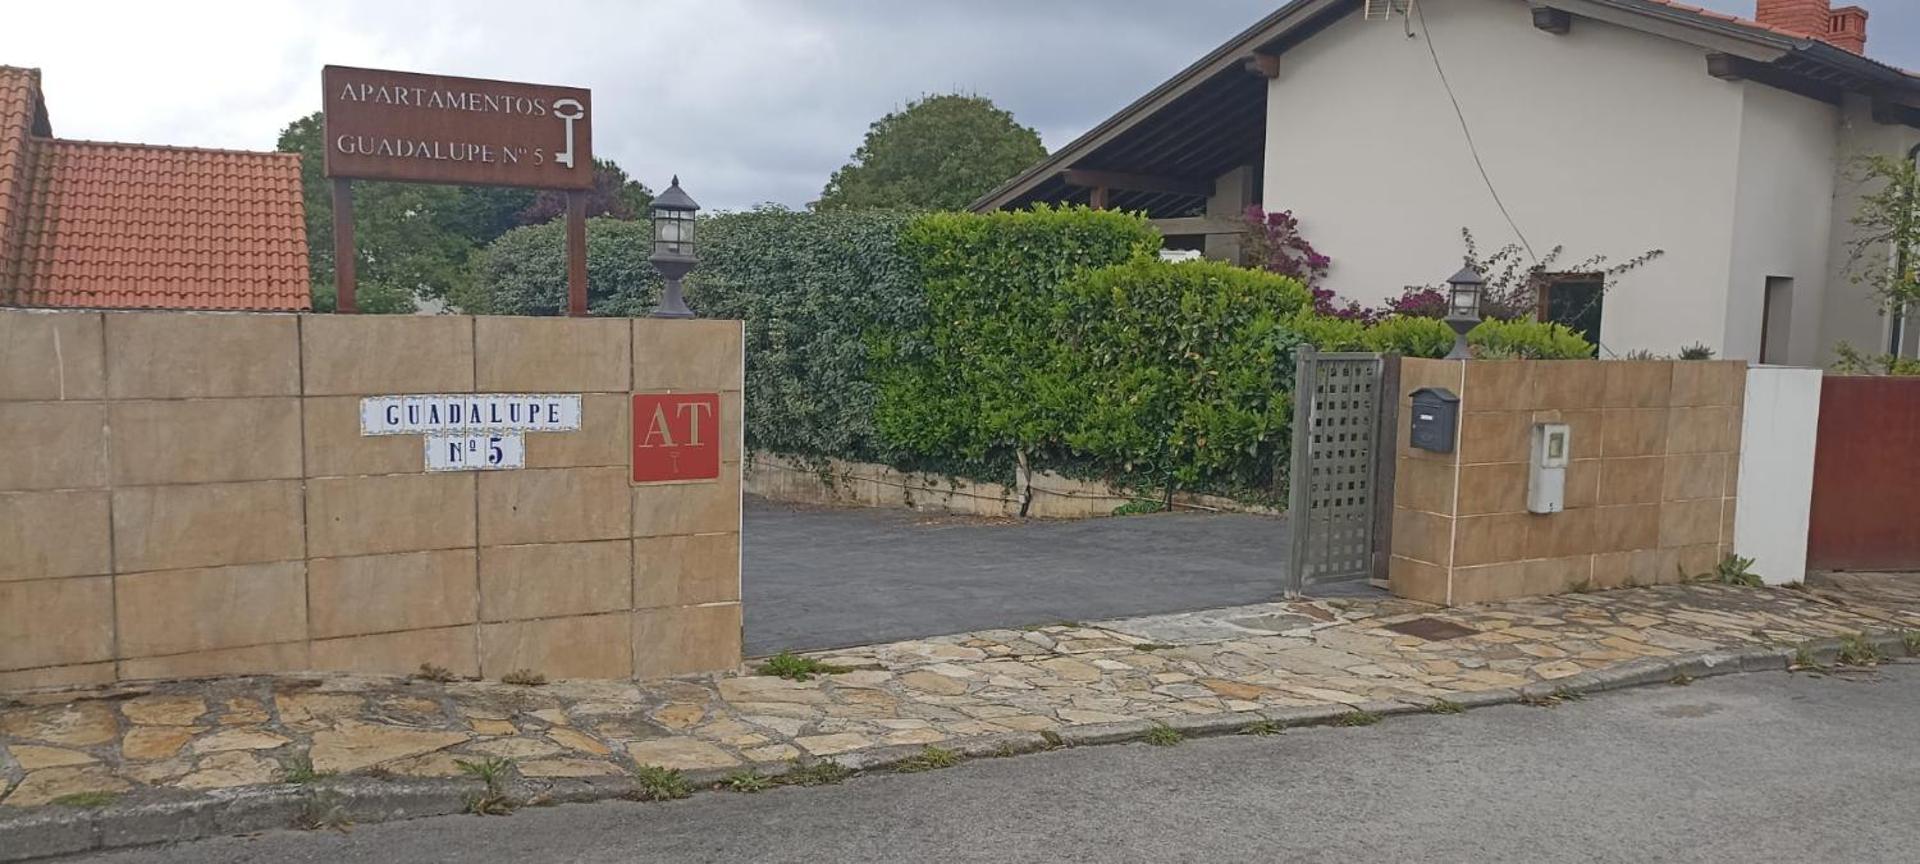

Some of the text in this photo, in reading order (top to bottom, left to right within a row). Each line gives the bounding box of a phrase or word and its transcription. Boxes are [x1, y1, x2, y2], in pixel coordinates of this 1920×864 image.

[340, 83, 546, 116] APARTAMENTOS
[337, 134, 495, 163] GUADALUPE
[534, 148, 544, 166] 5
[386, 403, 560, 425] GUADALUPE
[639, 401, 712, 448] AT
[488, 437, 503, 464] 5
